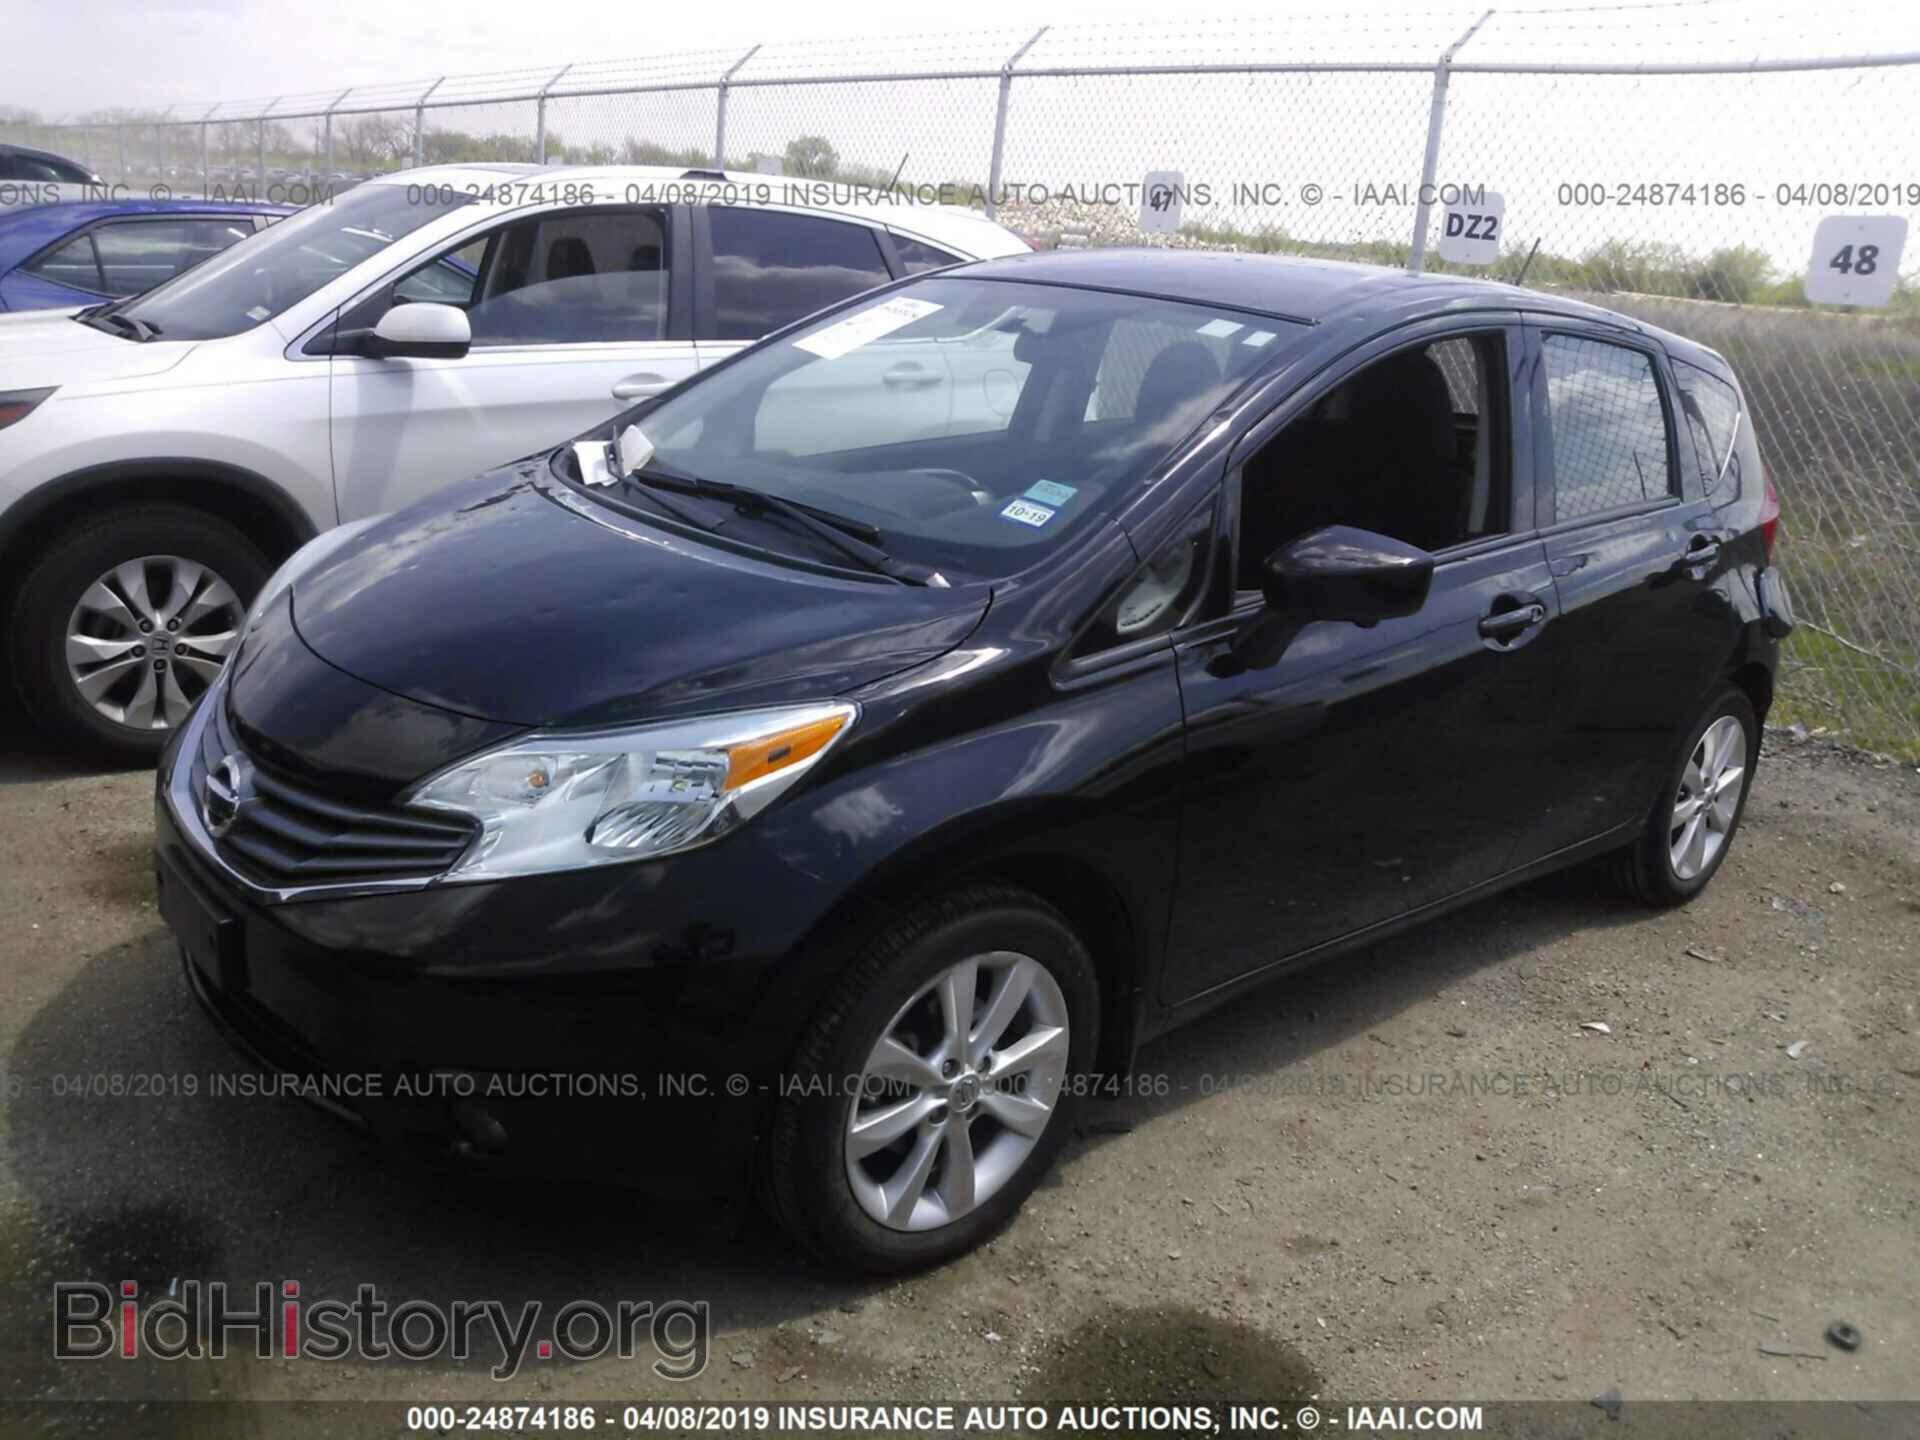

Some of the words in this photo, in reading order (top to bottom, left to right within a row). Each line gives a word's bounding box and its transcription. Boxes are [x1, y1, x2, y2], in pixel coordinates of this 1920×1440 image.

[1150, 191, 1173, 211] 47
[1446, 213, 1498, 241] DZ2
[1829, 244, 1879, 275] 48
